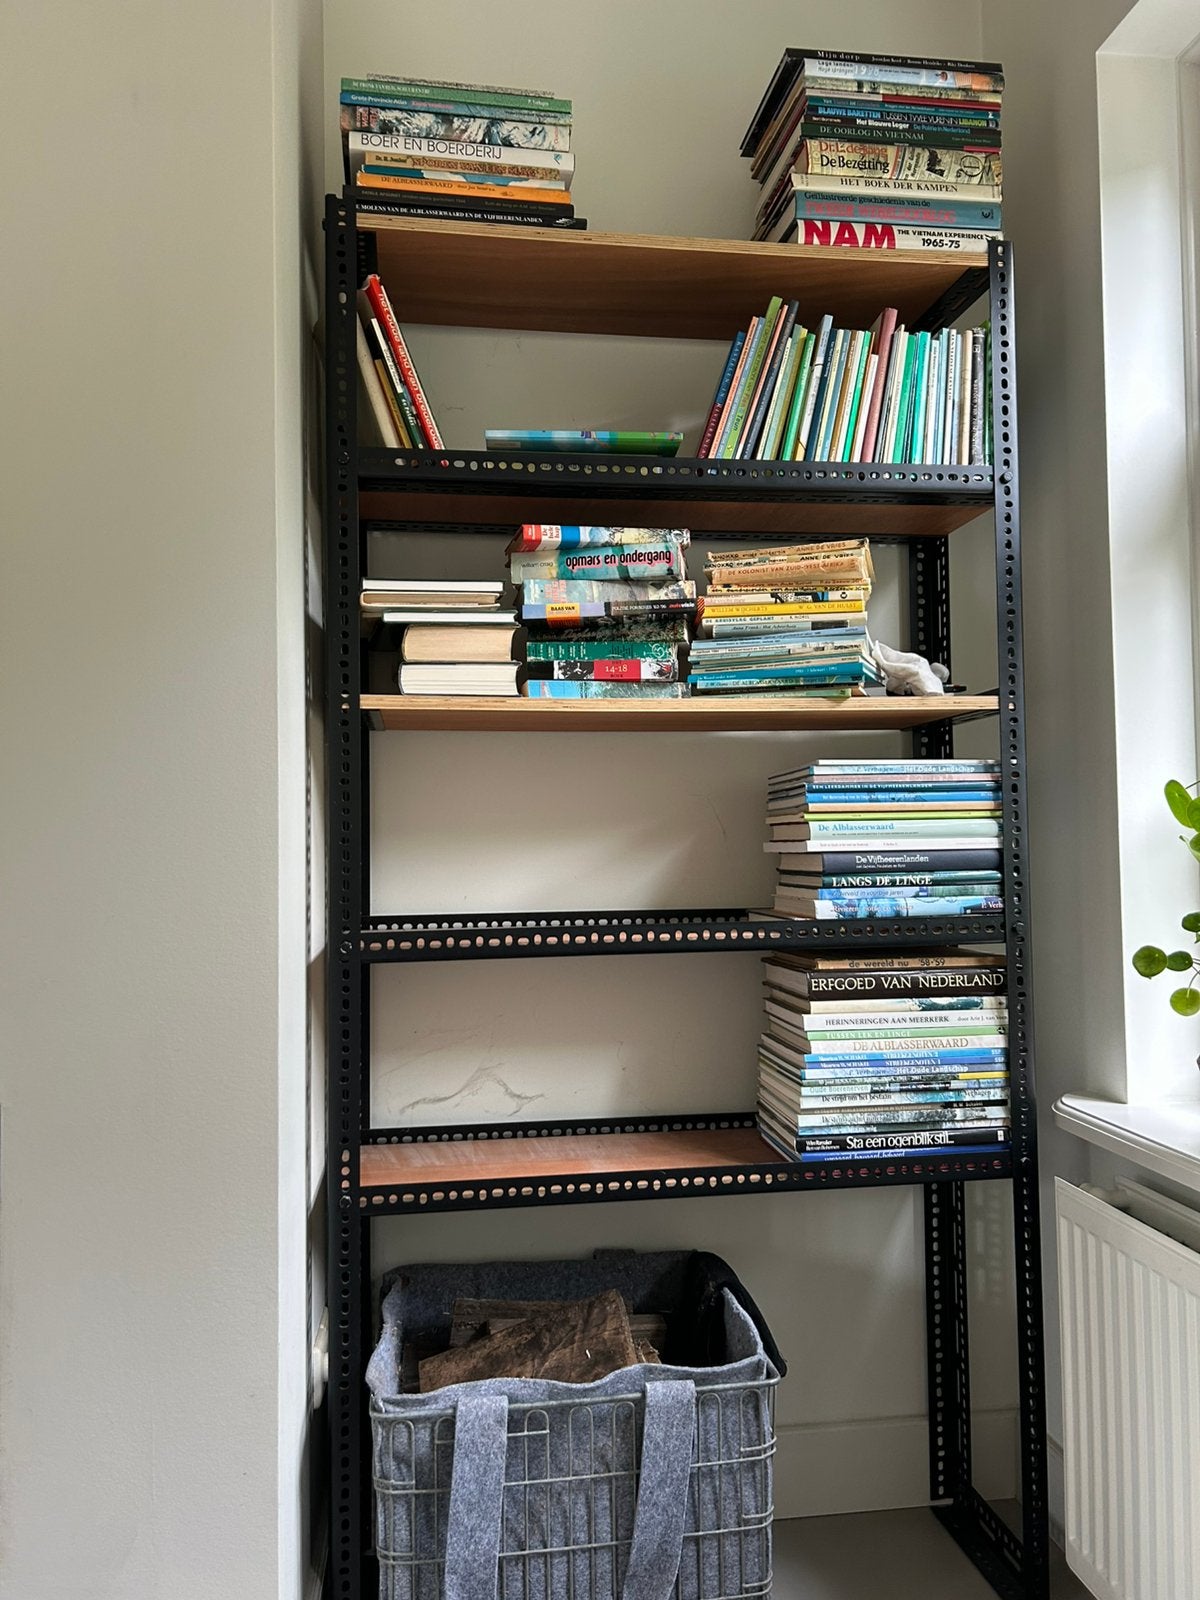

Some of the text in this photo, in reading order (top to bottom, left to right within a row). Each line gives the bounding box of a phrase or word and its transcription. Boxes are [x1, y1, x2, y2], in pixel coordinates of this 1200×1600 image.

[817, 50, 837, 58] Mijn
[818, 106, 846, 116] BLAUWE
[868, 119, 891, 127] Blauwe
[892, 121, 910, 130] Leger
[820, 126, 924, 140] DE OORLOG IN VIETNAM
[360, 133, 502, 159] BOER EN BOERDERIJ
[820, 141, 835, 152] Dr.
[846, 143, 860, 153] de
[820, 154, 889, 173] De Bezetting
[840, 178, 958, 192] HET BOEK DER KAMPEN
[803, 220, 897, 250] NAM
[912, 230, 944, 238] VIETNAM
[944, 231, 984, 240] EXPERIENCE
[921, 238, 960, 249] 1965-75
[407, 370, 419, 391] van
[734, 413, 743, 431] Teun
[566, 549, 672, 570] opmars en ondergang
[738, 567, 769, 575] KOLONIST
[605, 664, 628, 673] 14-18
[818, 823, 894, 832] De Alblasserwaard
[855, 854, 929, 865] De Vijfheerenlanden
[832, 875, 933, 887] LANGS DE LINGE
[811, 973, 1004, 991] ERFGOED VAN NEDERLAND
[825, 1018, 889, 1026] HERINNERINGEN
[852, 1037, 969, 1051] DE ALBLASSERWAARD
[846, 1135, 864, 1149] Sta
[865, 1137, 886, 1149] een
[887, 1133, 933, 1148] ogenblik
